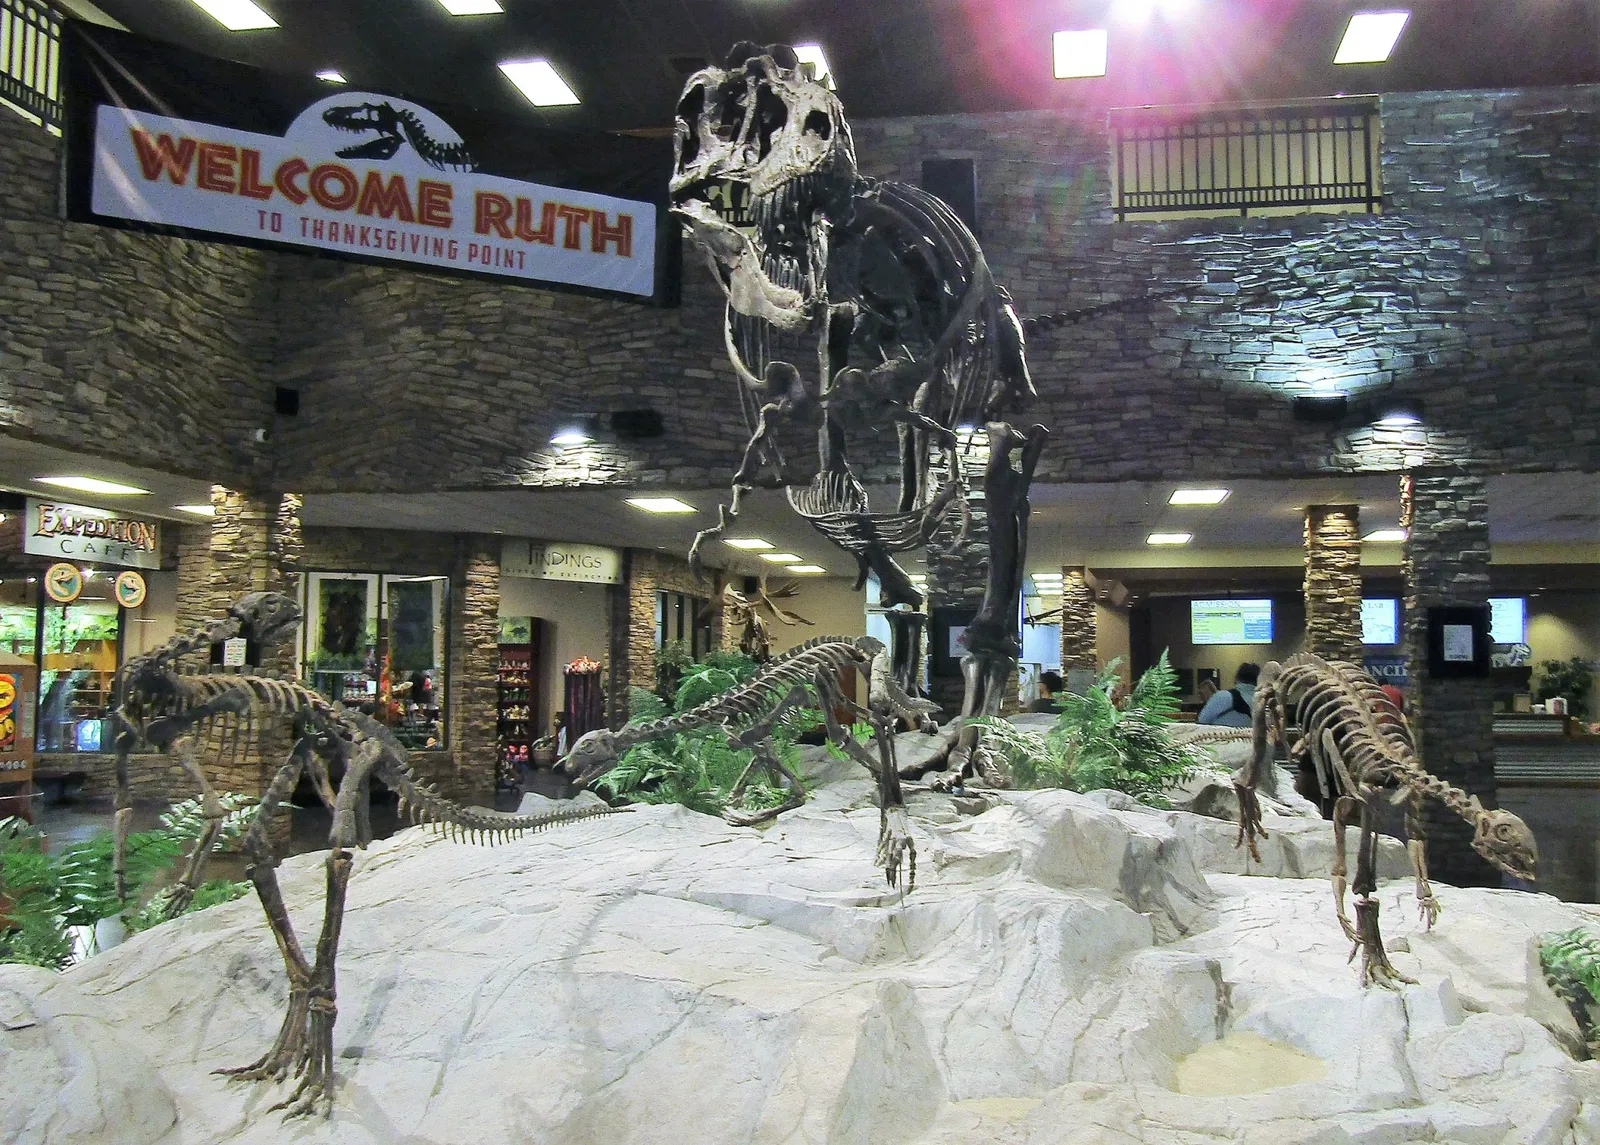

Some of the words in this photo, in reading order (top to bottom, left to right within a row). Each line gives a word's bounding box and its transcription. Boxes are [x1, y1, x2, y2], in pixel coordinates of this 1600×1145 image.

[129, 126, 454, 230] WELCOME
[474, 190, 634, 258] RUTH
[257, 209, 282, 233] TO
[300, 216, 458, 261] THANKSGIVING
[468, 242, 526, 271] POINT
[32, 503, 157, 552] EXPEDITION
[1192, 600, 1241, 608] ADMISSION
